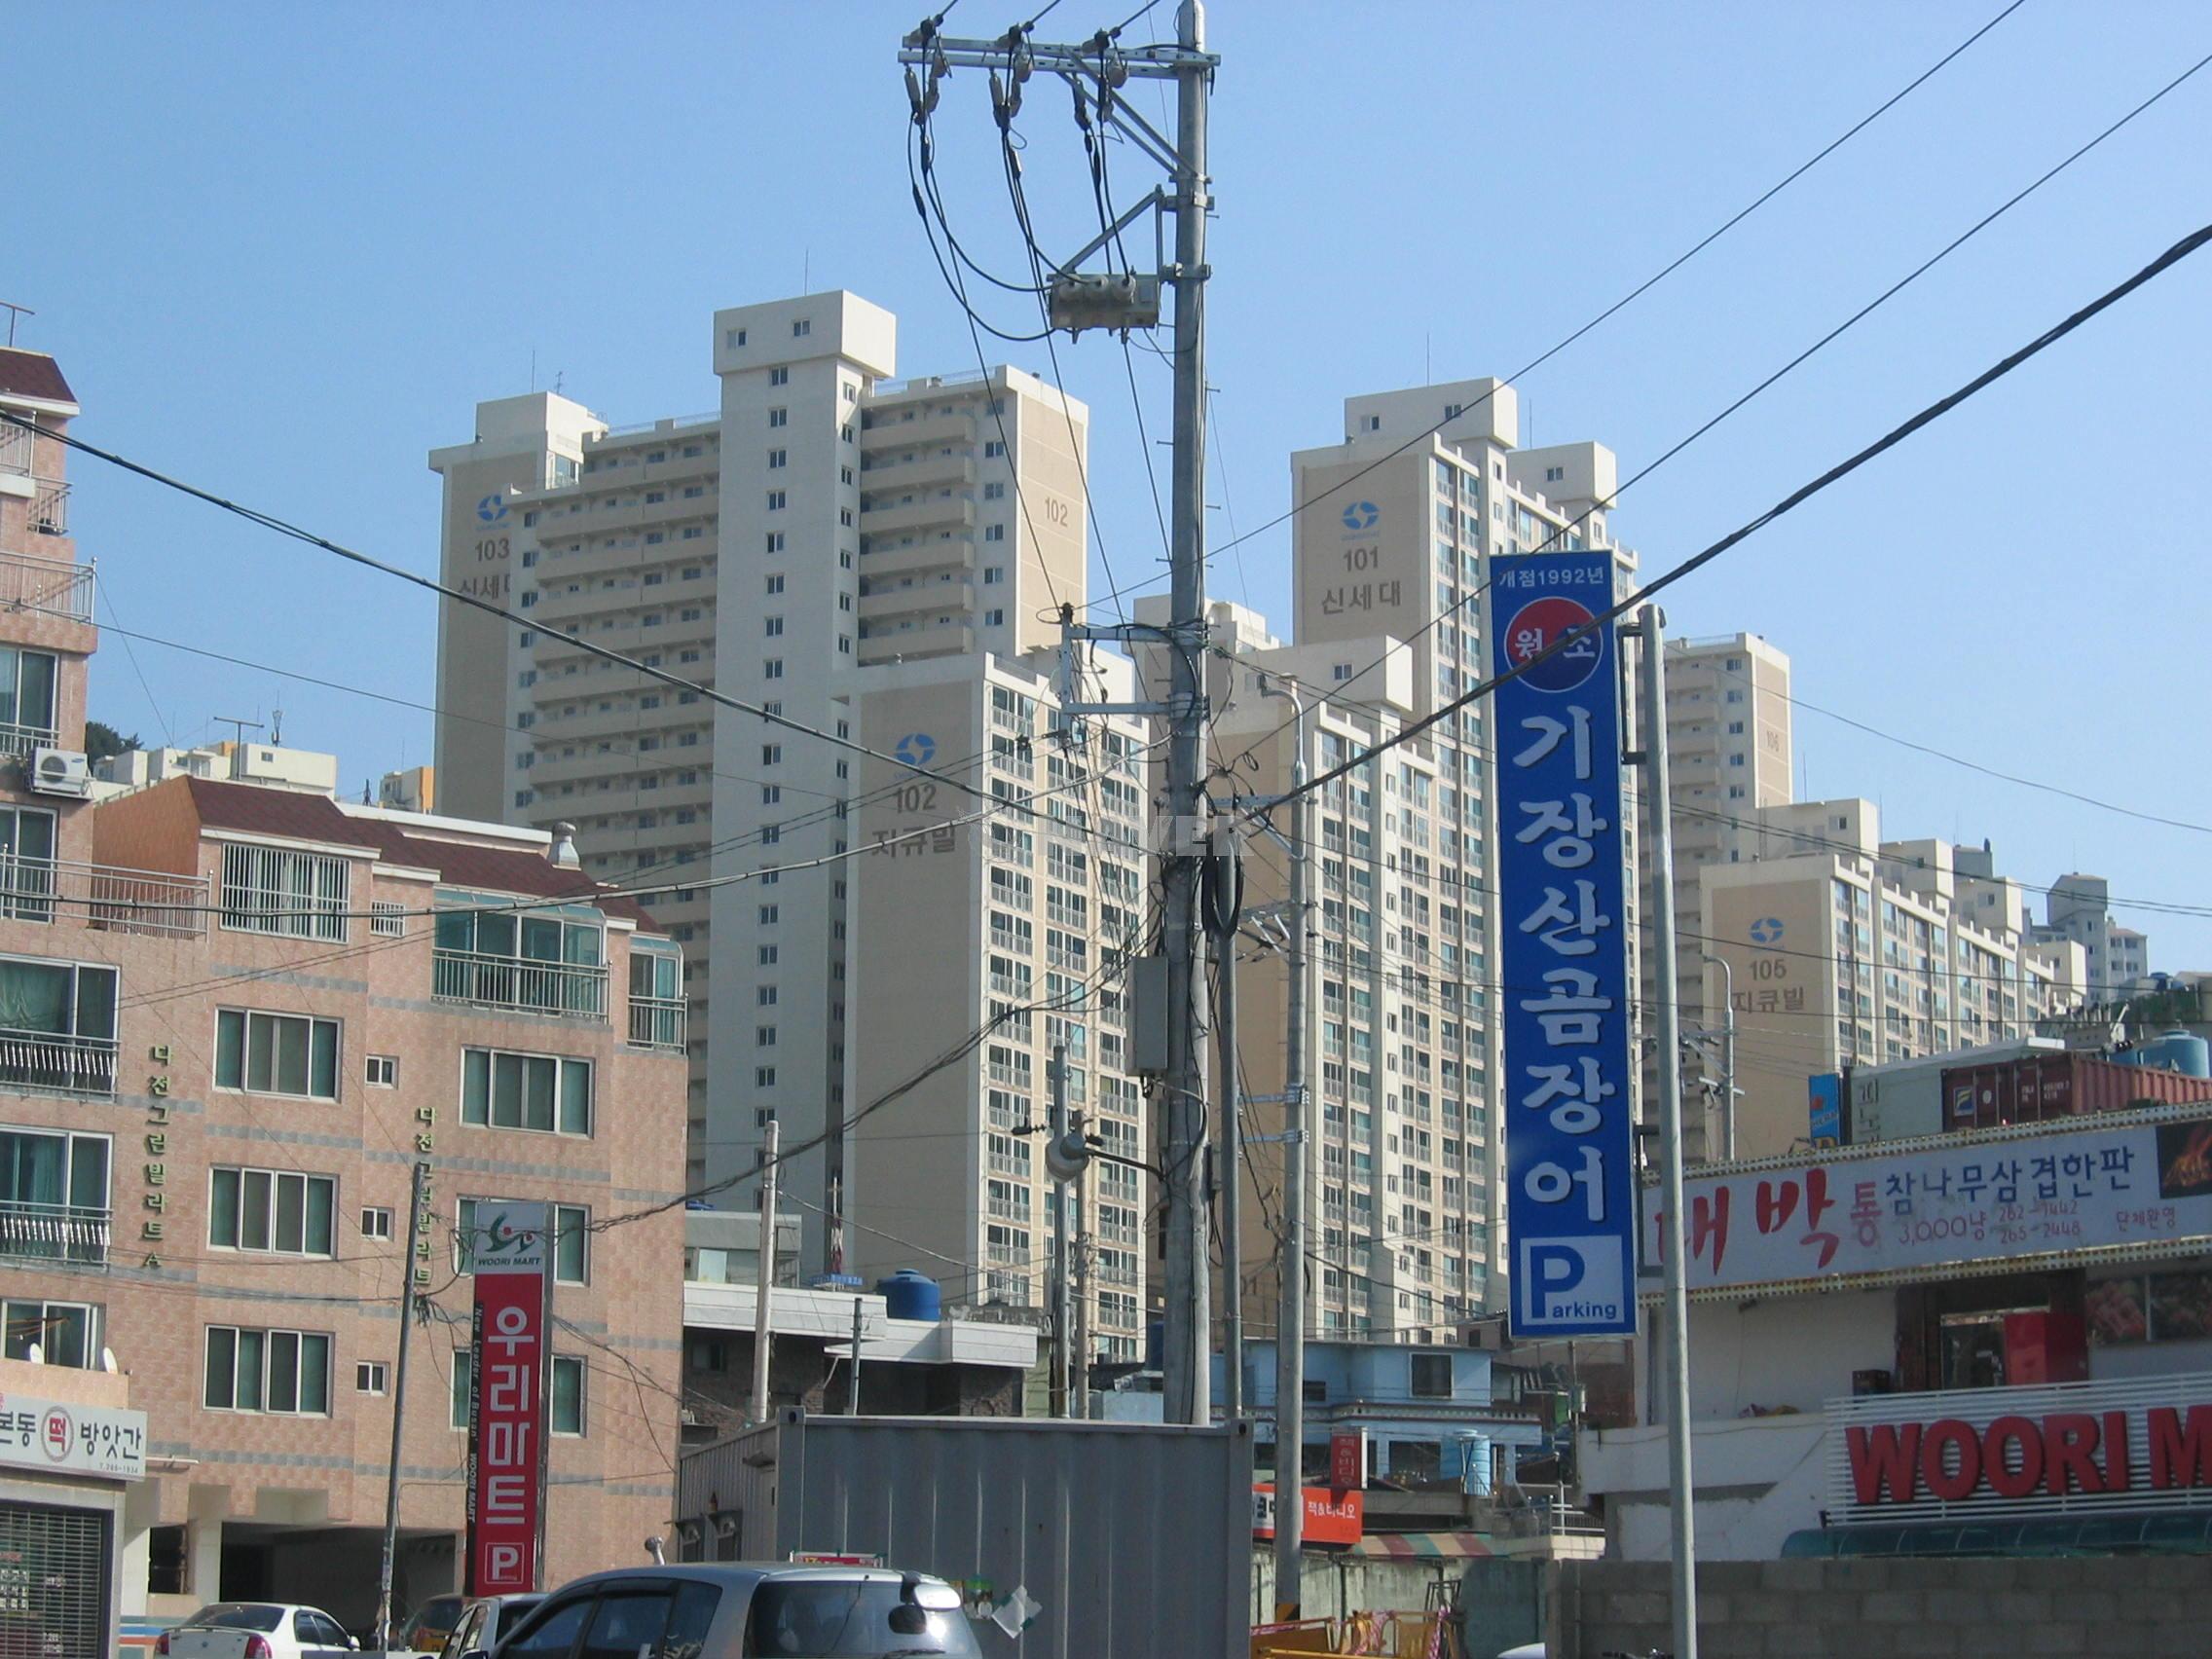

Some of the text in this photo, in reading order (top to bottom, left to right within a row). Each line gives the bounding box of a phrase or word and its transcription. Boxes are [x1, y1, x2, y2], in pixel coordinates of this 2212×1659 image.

[1045, 497, 1068, 528] 102
[474, 537, 510, 562] 103
[1344, 545, 1379, 572] 101
[1499, 567, 1604, 588] 개점1992년
[1322, 580, 1401, 615] 신세대
[895, 784, 937, 813] 102
[1750, 958, 1788, 981] 105
[478, 1257, 541, 1266] WOORI MART
[472, 1340, 483, 1380] Leader
[471, 1385, 480, 1400] of
[486, 1306, 535, 1525] 우리마트
[49, 1417, 66, 1453] 떡
[81, 1422, 142, 1460] 방앗간
[468, 1453, 478, 1490] WOORI
[1845, 1411, 2130, 1505] WOORI
[467, 1491, 477, 1524] MART
